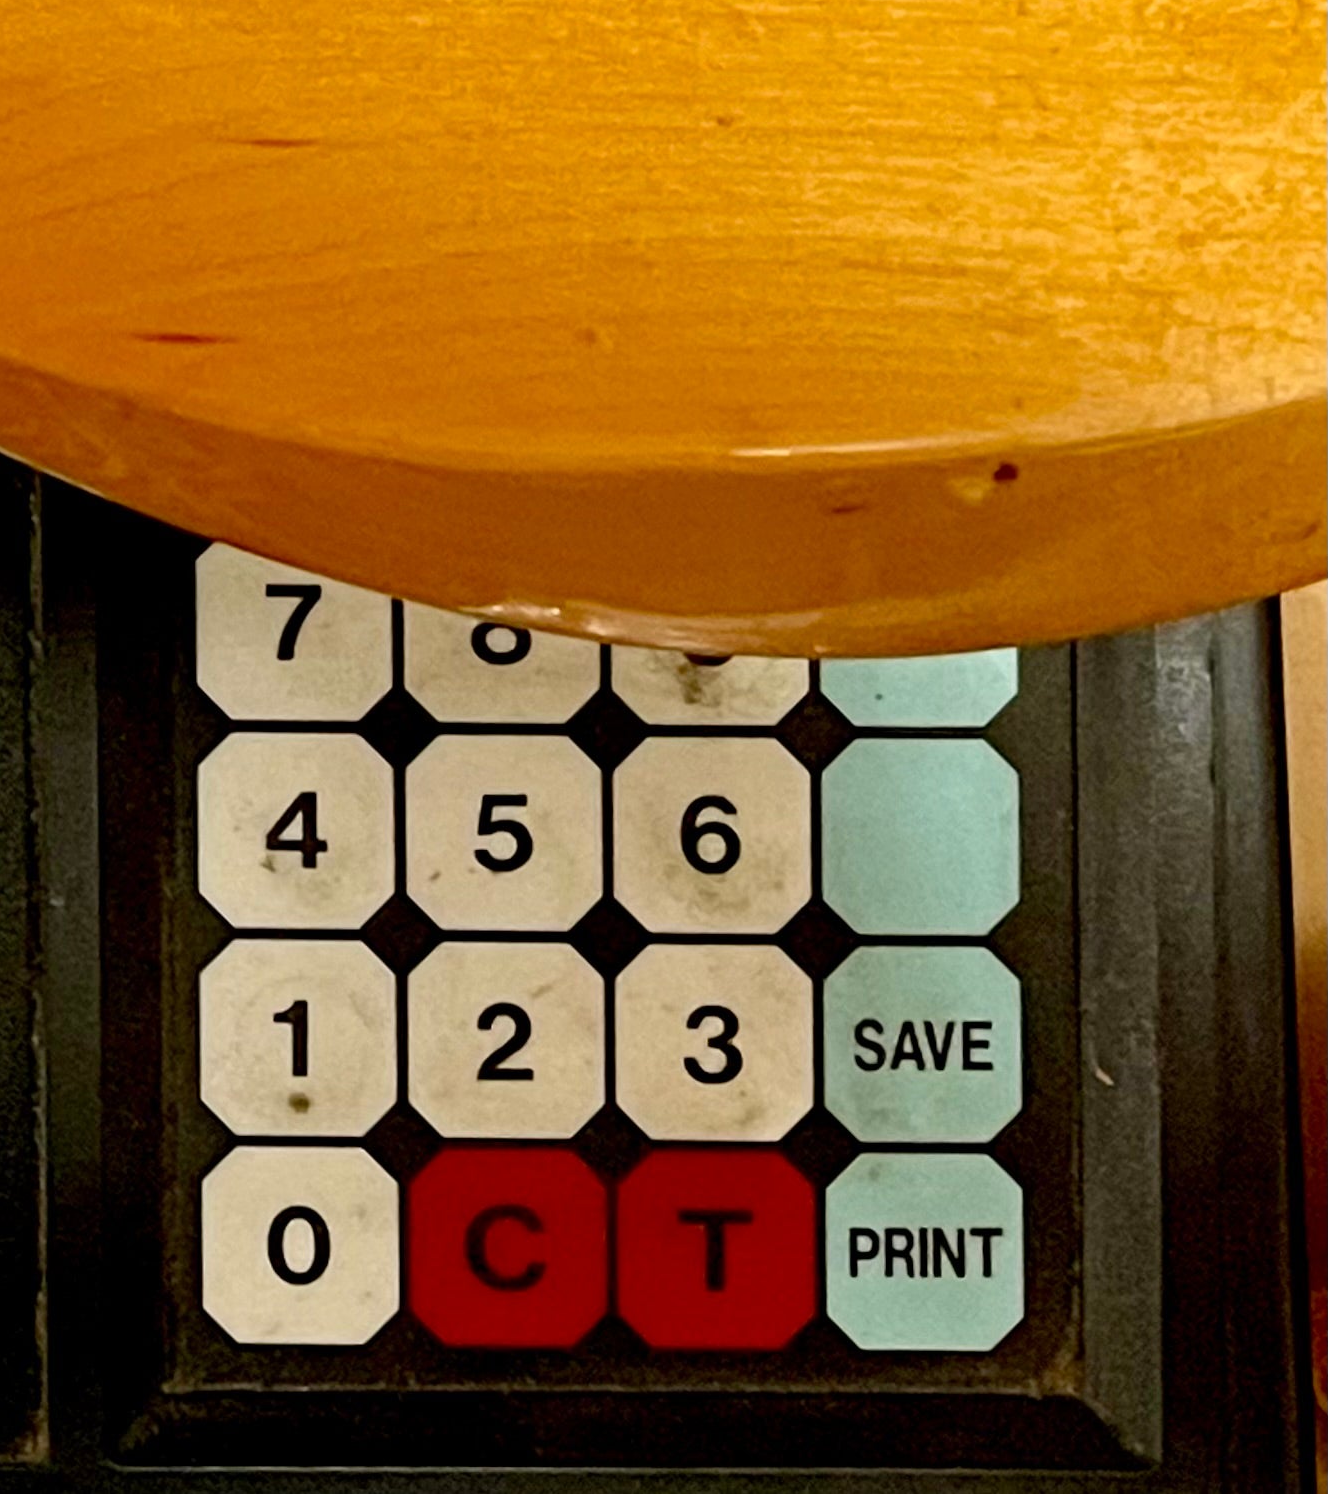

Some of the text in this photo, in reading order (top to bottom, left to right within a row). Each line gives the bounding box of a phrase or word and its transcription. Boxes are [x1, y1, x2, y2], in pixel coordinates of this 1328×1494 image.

[265, 583, 323, 661] 7
[265, 791, 328, 869] 4
[474, 794, 533, 873] 5
[680, 795, 741, 875] 6
[273, 1000, 308, 1077] 1
[476, 1002, 534, 1081] 2
[683, 1005, 743, 1084] 3
[853, 1018, 994, 1072] SAVE
[465, 1205, 546, 1291] C
[678, 1209, 754, 1291] T
[848, 1227, 1004, 1279] PRINT
